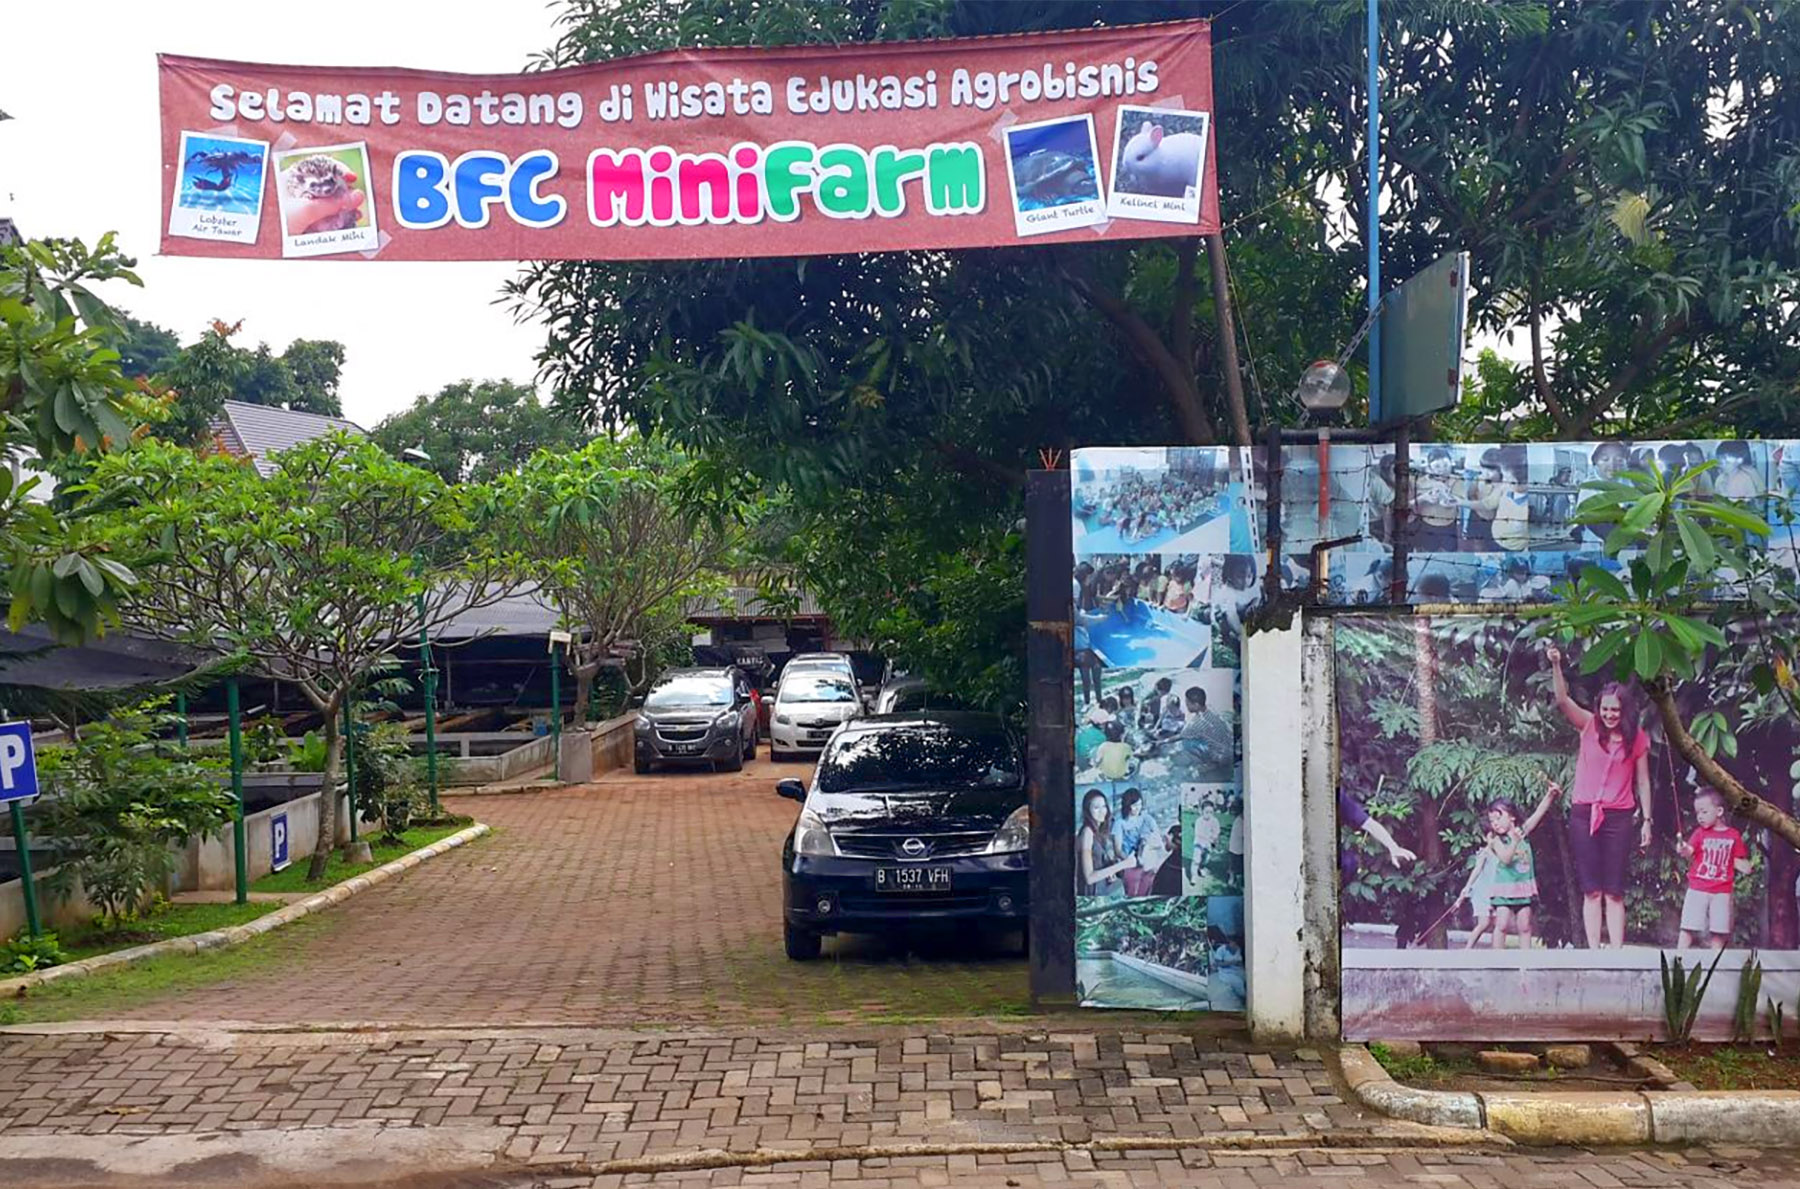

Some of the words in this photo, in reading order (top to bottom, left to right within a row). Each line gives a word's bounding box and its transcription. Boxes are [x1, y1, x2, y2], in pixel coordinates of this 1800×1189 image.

[209, 83, 401, 125] Selamat
[416, 91, 584, 128] Datang
[599, 84, 633, 122] di
[643, 79, 774, 119] Wisata
[786, 73, 938, 114] Edukasi
[951, 57, 1160, 110] Agrobisnis
[392, 149, 568, 230] BFC
[1026, 211, 1058, 224] Giant
[1062, 206, 1095, 218] Turtle
[1162, 202, 1186, 212] Mini
[199, 213, 238, 227] Lobster
[191, 224, 208, 232] Air
[211, 225, 243, 236] Tawar
[294, 235, 337, 247] Landak
[341, 230, 365, 241] Mini
[0, 734, 26, 790] P
[274, 822, 285, 859] P
[877, 869, 886, 884] B
[896, 868, 923, 883] 1537
[927, 867, 949, 883] VFH
